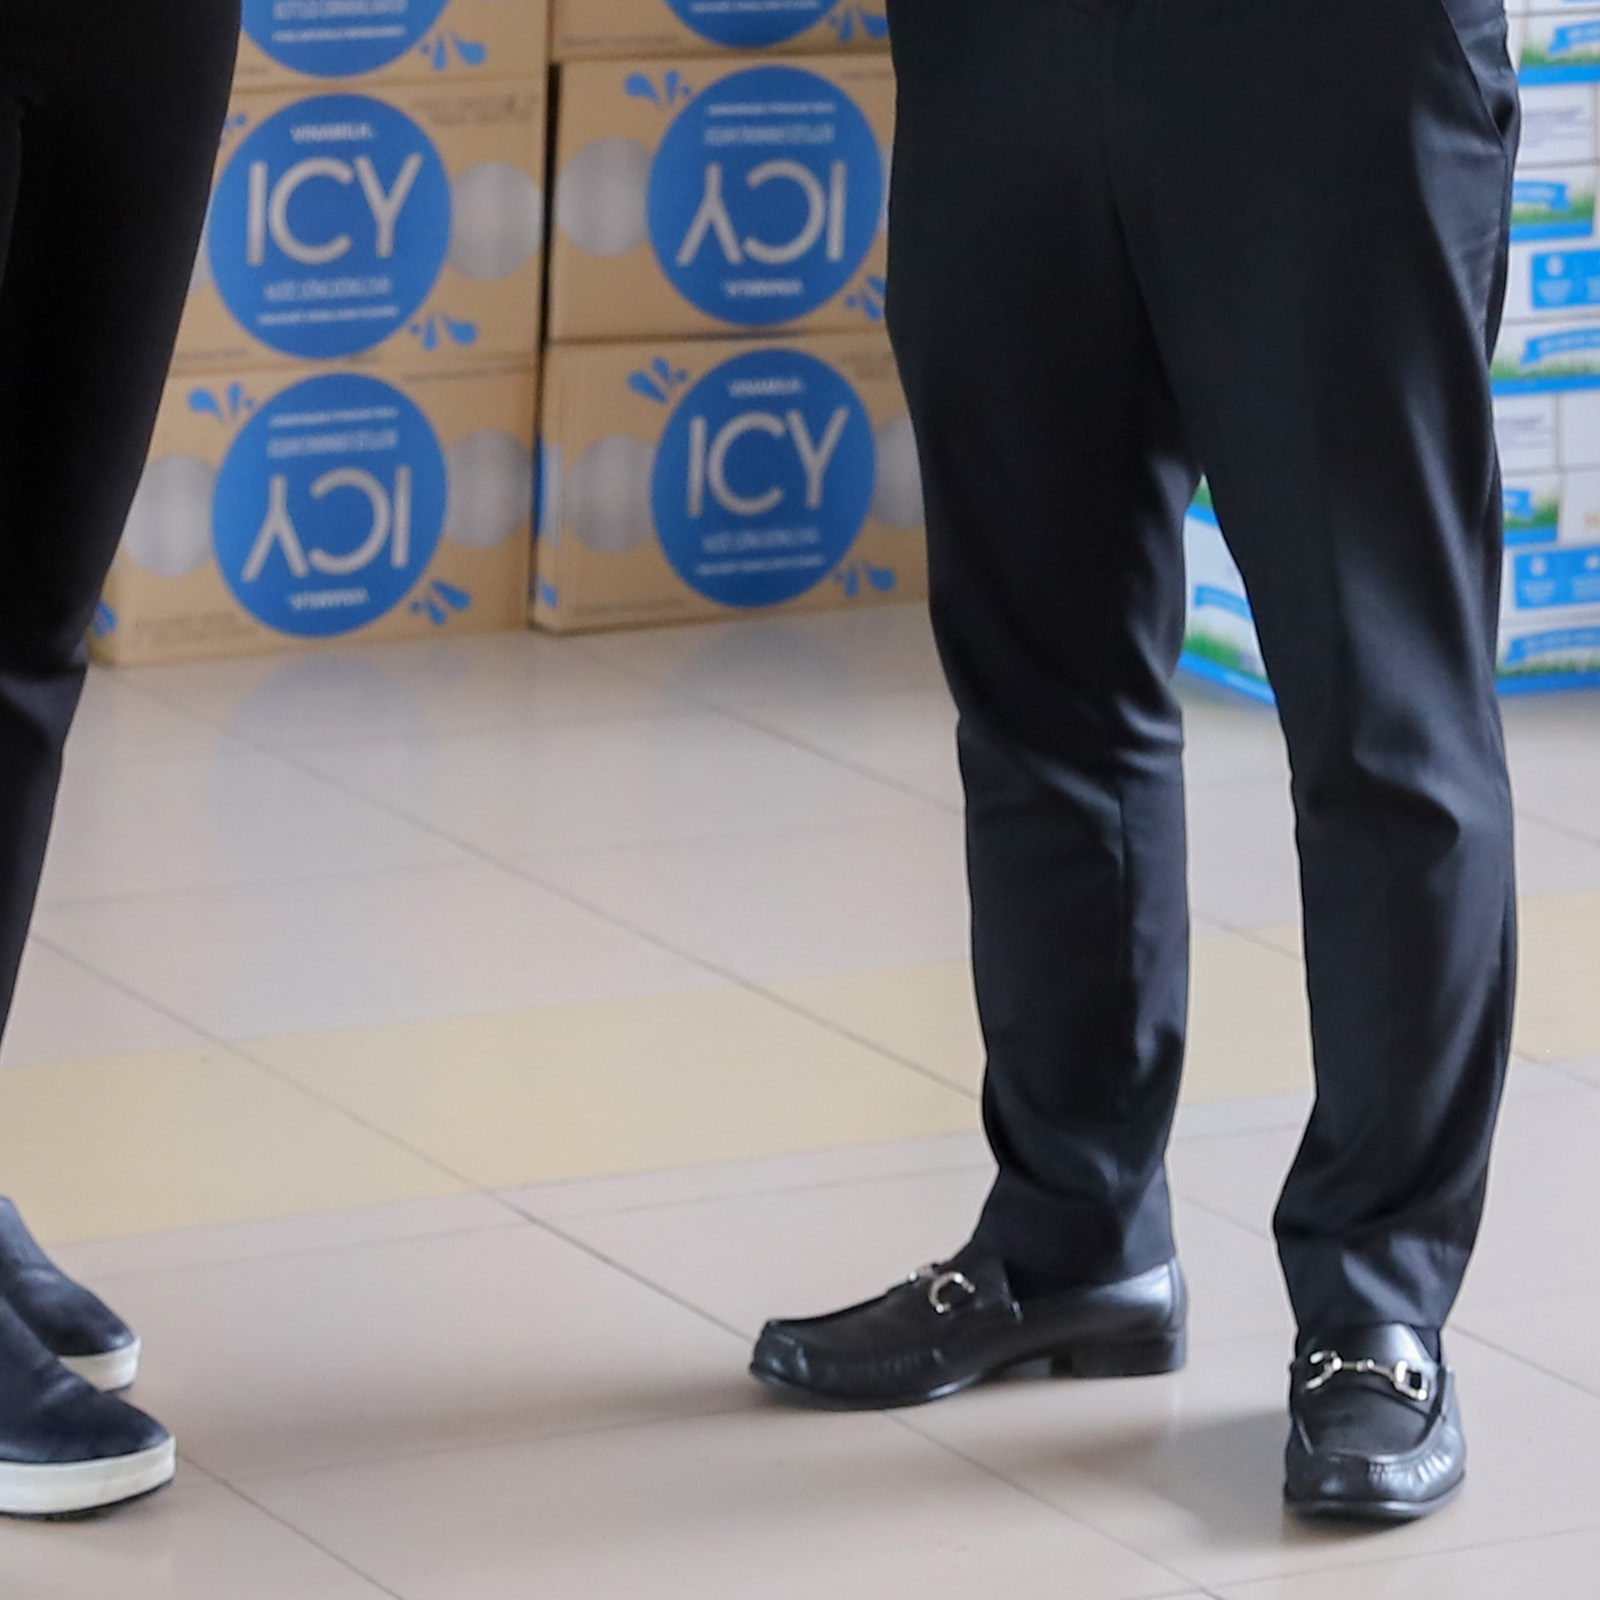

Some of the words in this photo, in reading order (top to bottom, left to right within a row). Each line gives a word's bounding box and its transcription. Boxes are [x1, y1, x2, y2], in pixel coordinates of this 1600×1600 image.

[247, 154, 422, 265] ICY
[677, 161, 846, 265] ICY
[688, 408, 849, 516] ICY
[242, 466, 411, 581] ICY
